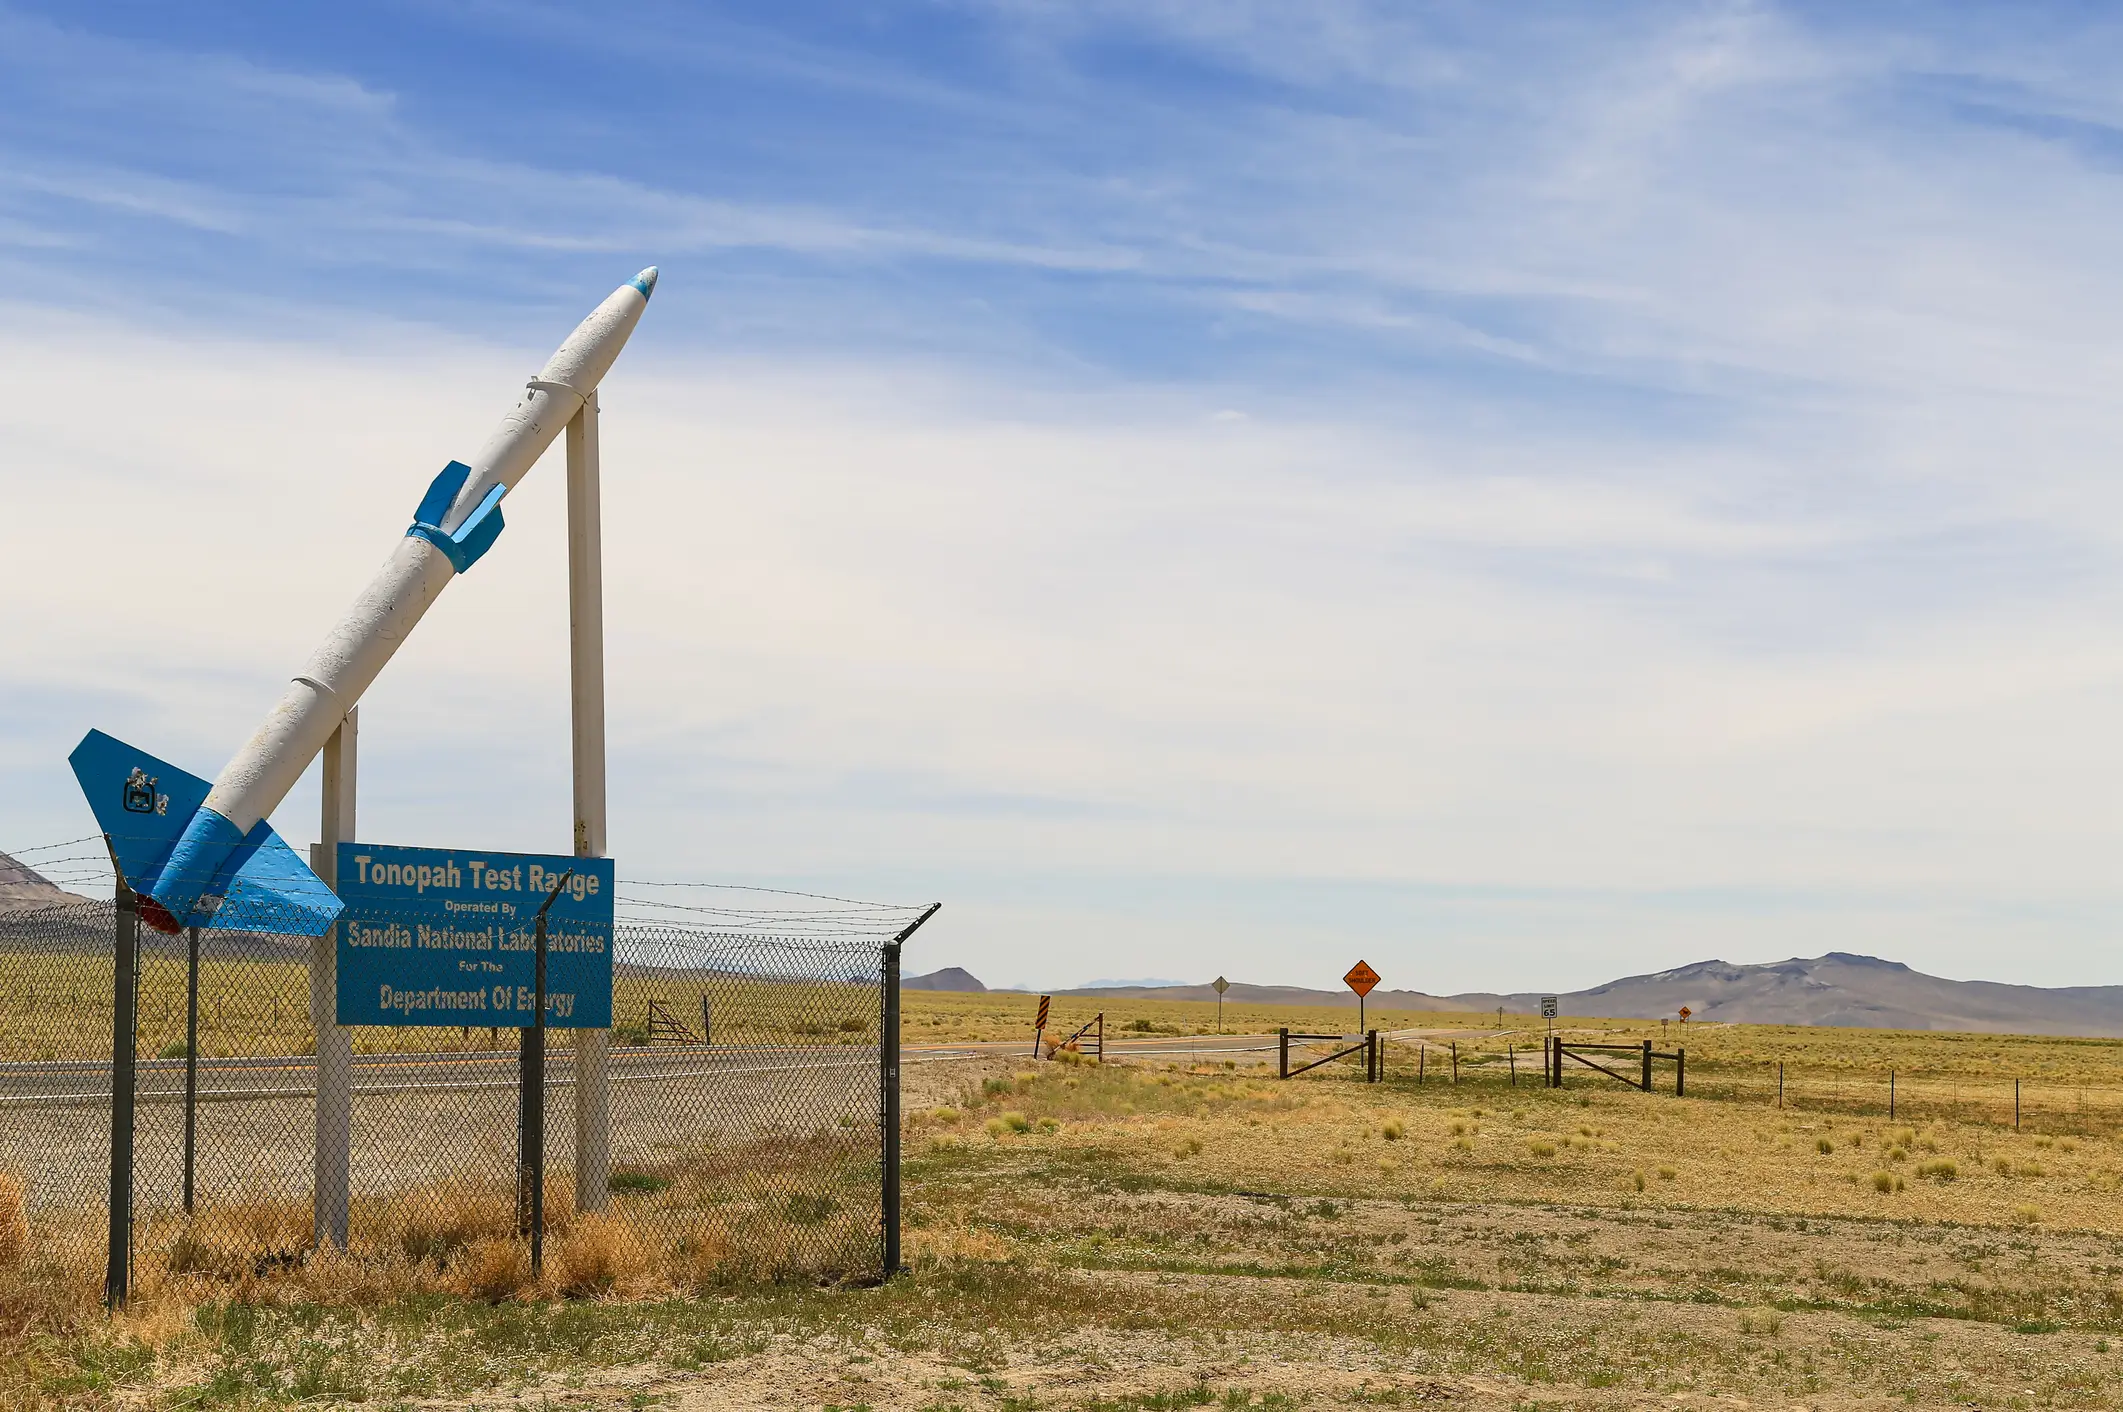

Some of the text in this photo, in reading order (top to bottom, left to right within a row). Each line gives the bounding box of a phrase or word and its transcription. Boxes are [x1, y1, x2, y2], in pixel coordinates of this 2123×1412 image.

[355, 856, 600, 901] Tonopah Test Range
[445, 901, 516, 916] Operated By
[348, 921, 604, 953] Sandia National Laboatories
[458, 960, 504, 973] For The
[380, 984, 487, 1016] Department
[492, 985, 512, 1010] Of
